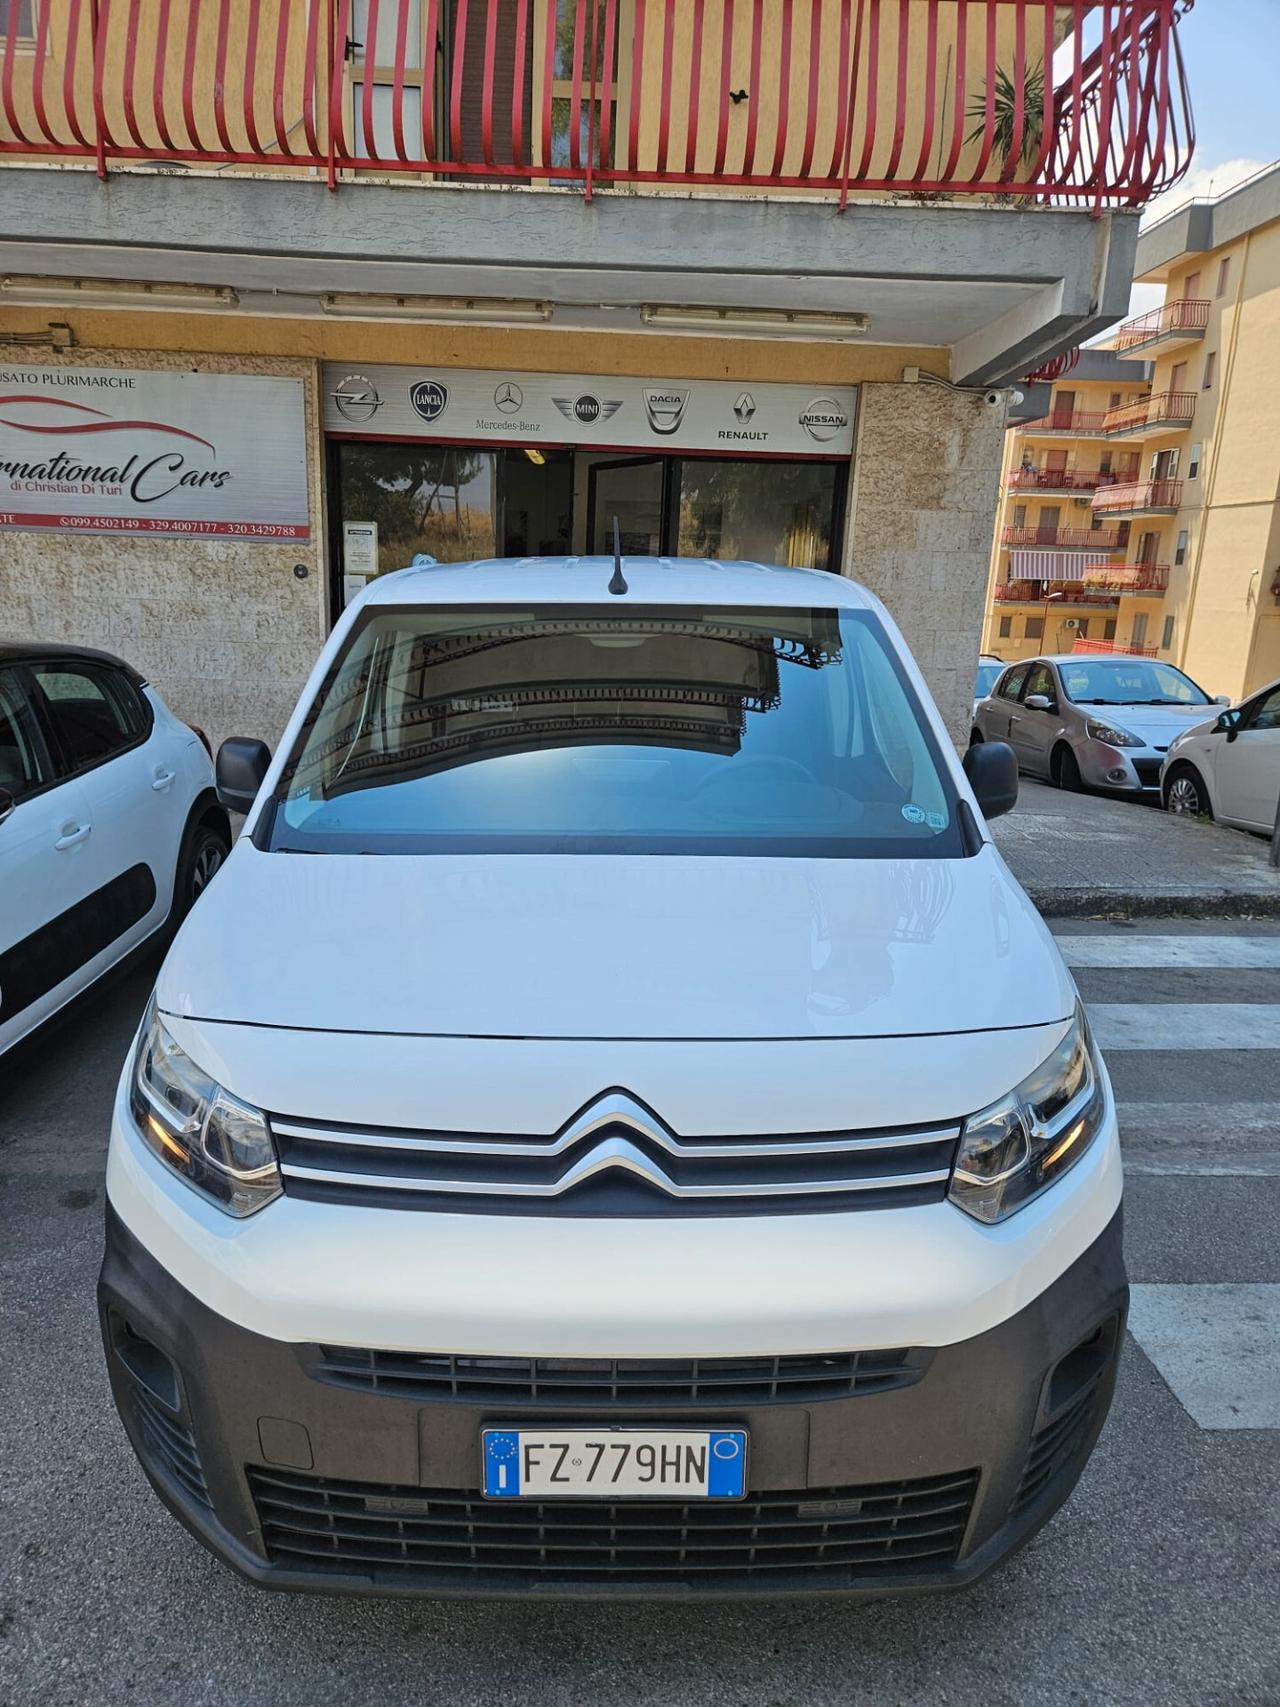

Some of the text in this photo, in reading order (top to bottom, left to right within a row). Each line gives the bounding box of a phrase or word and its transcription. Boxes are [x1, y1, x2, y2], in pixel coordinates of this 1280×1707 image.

[0, 372, 136, 388] SATO PLURIMARCHE
[416, 394, 441, 406] LANCIA
[650, 395, 681, 404] DACIA
[576, 404, 598, 414] MINI
[476, 420, 541, 432] Mercedes-Benz
[803, 415, 843, 425] NISSAN
[718, 430, 769, 441] RENAULT
[130, 453, 233, 503] Cars
[10, 480, 122, 495] di Christian Di Turi
[70, 517, 139, 529] 099.4502149
[149, 521, 217, 534] 329.4007177
[227, 525, 296, 537] 320.3429788
